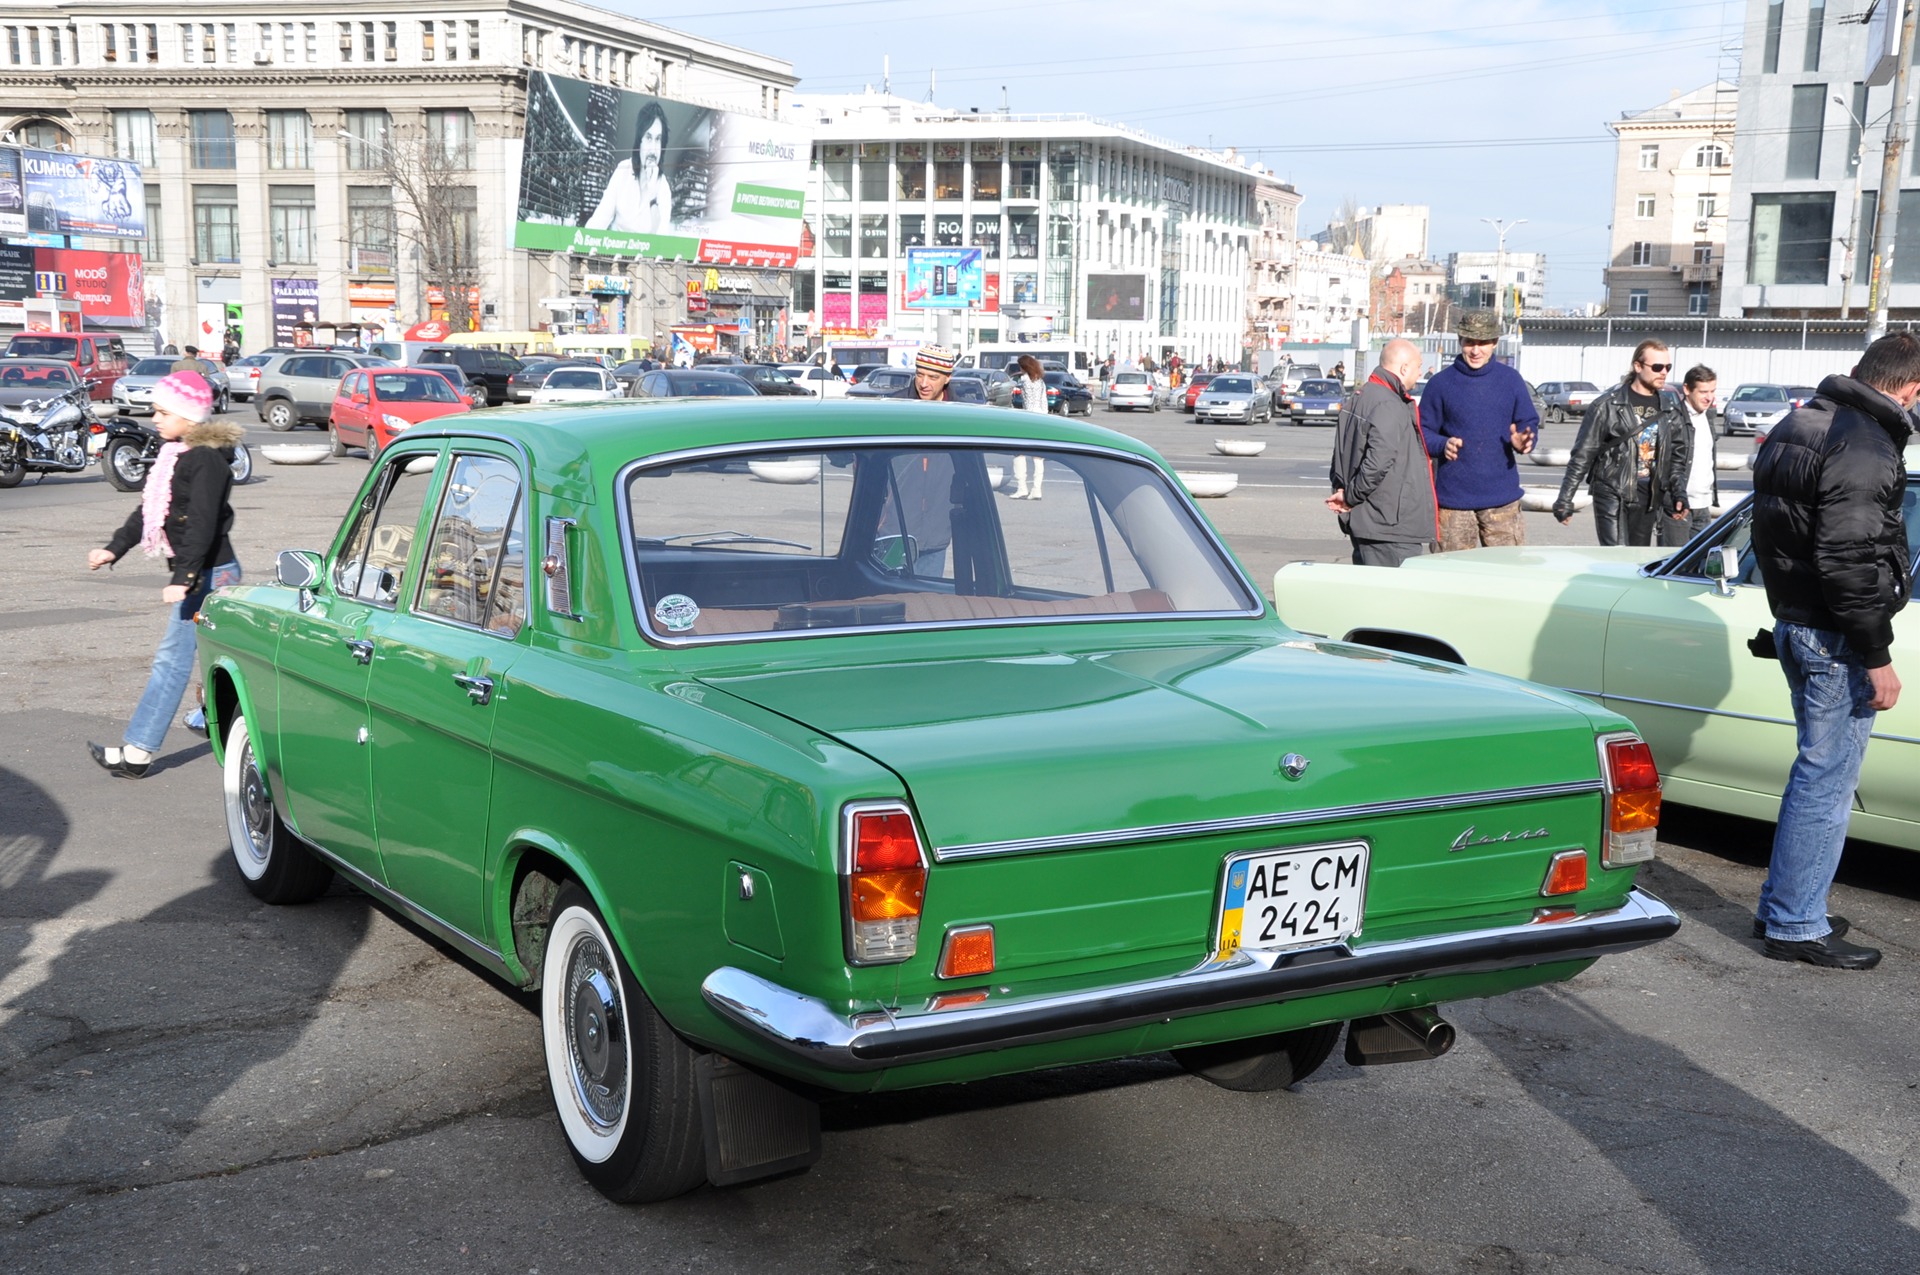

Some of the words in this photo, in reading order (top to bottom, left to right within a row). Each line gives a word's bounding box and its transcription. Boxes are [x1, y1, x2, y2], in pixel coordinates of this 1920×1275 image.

[24, 158, 76, 178] KUMHO
[584, 234, 601, 247] Банк
[602, 236, 628, 250] Кредит
[627, 238, 650, 252] Дніпро
[75, 280, 107, 288] STUDIO
[274, 287, 319, 296] PALLADIUM
[73, 291, 111, 305] Витражи
[1246, 860, 1291, 901] AE
[1310, 853, 1360, 892] CM
[1258, 896, 1341, 942] 2424
